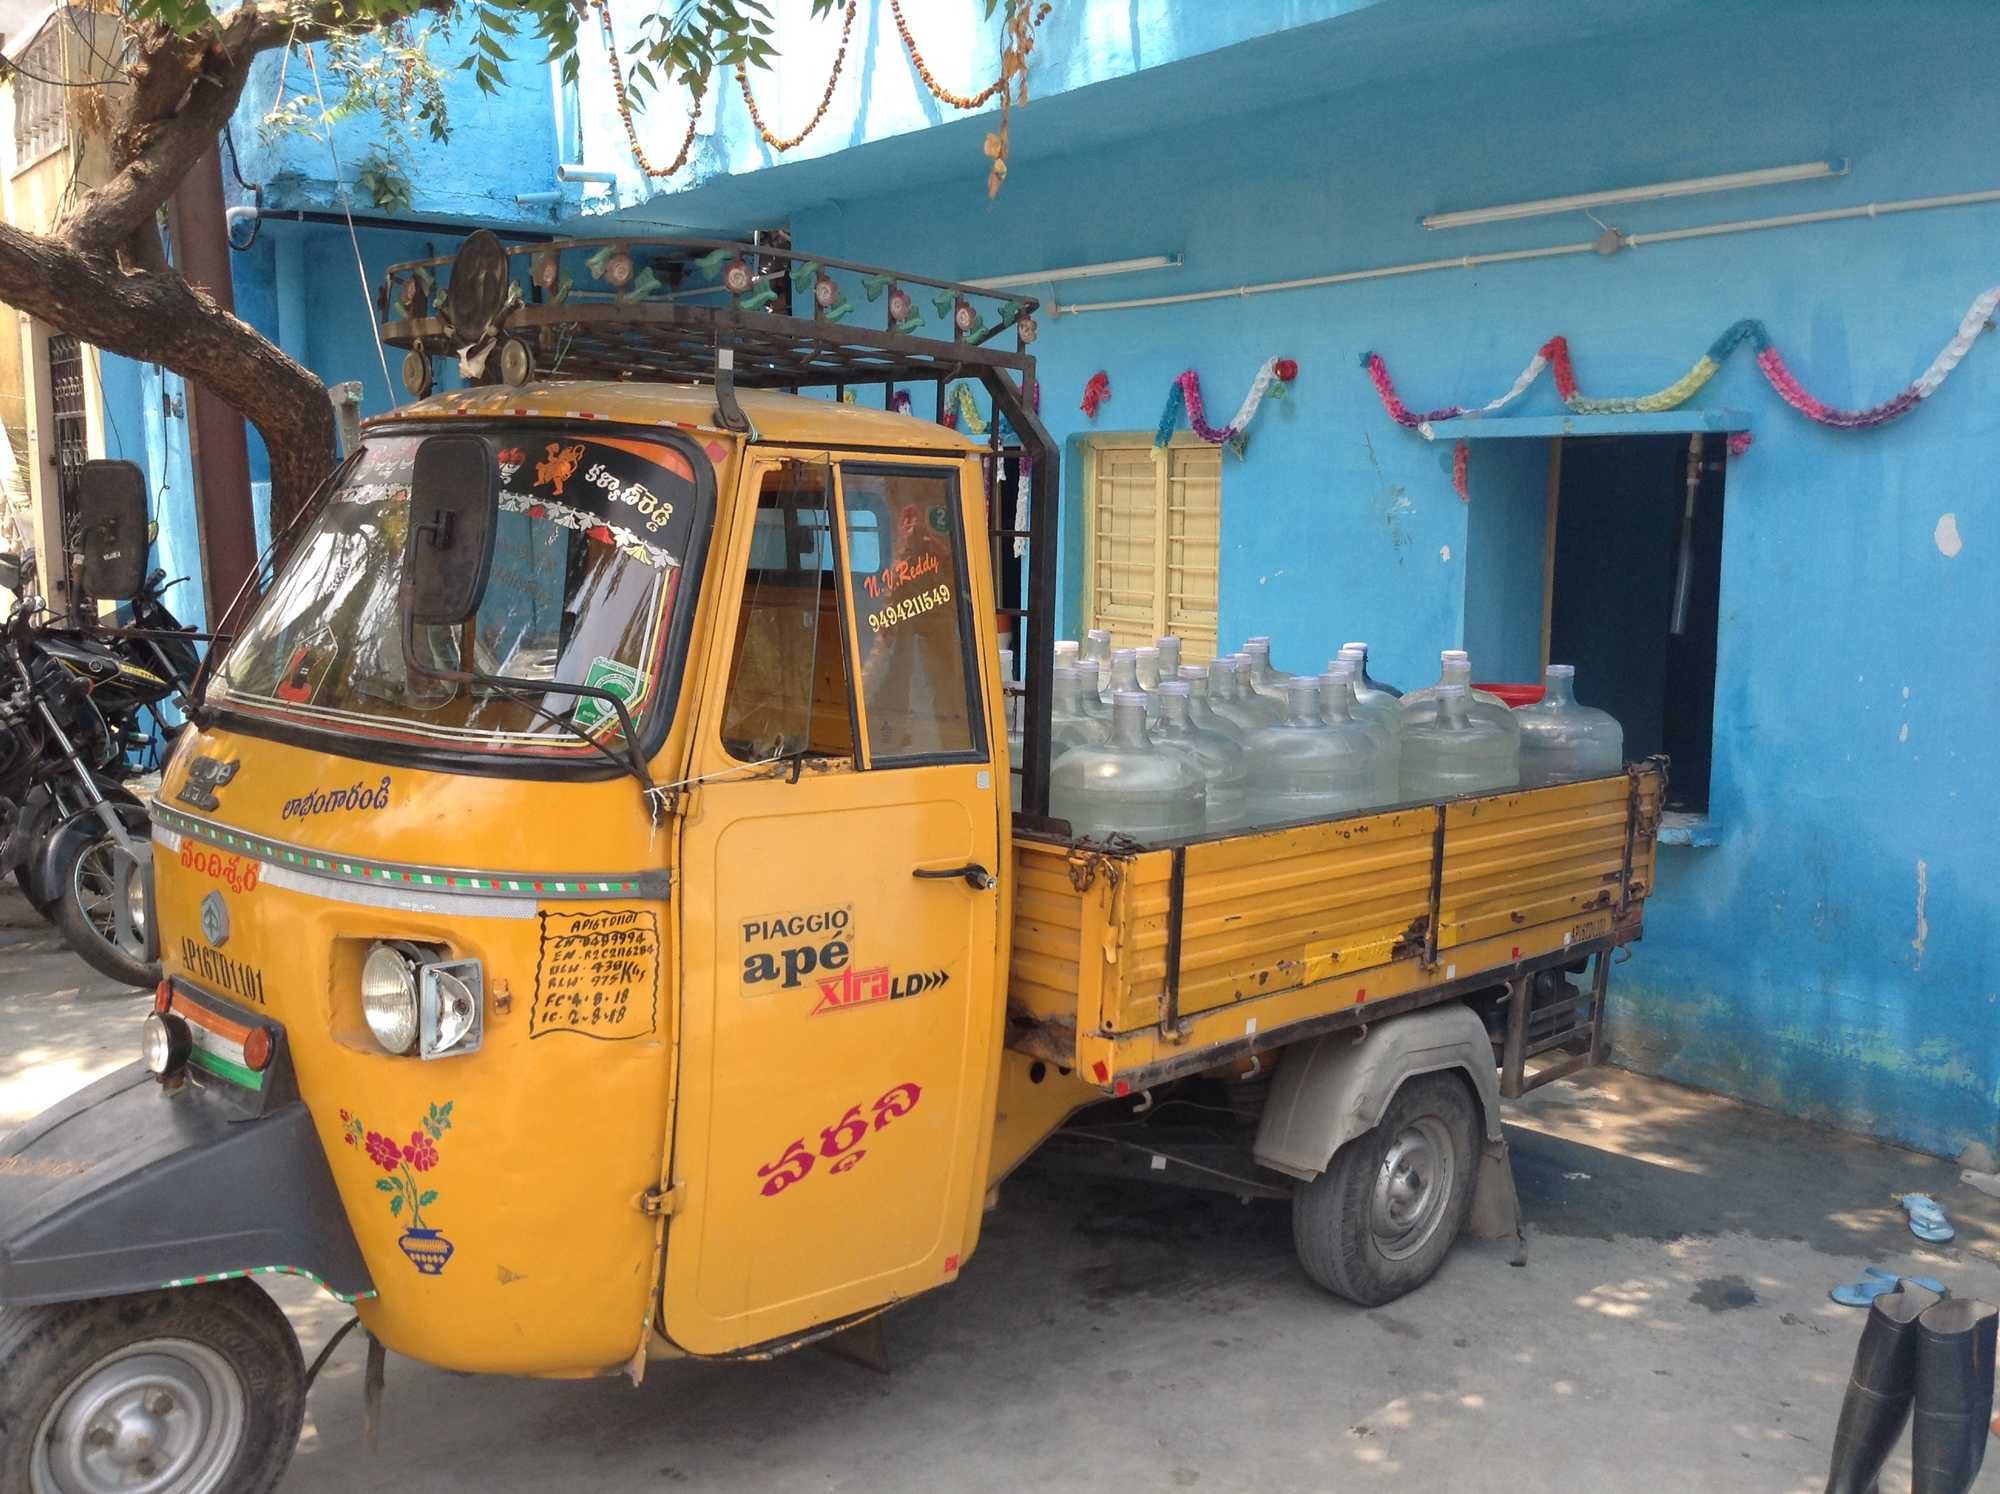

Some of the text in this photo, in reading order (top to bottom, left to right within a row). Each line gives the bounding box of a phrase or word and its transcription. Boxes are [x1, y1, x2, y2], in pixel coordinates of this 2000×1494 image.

[868, 584, 951, 632] 9494211549
[570, 912, 638, 933] AP16TD1101
[742, 910, 850, 943] PIAGGIO
[743, 930, 850, 989] apé
